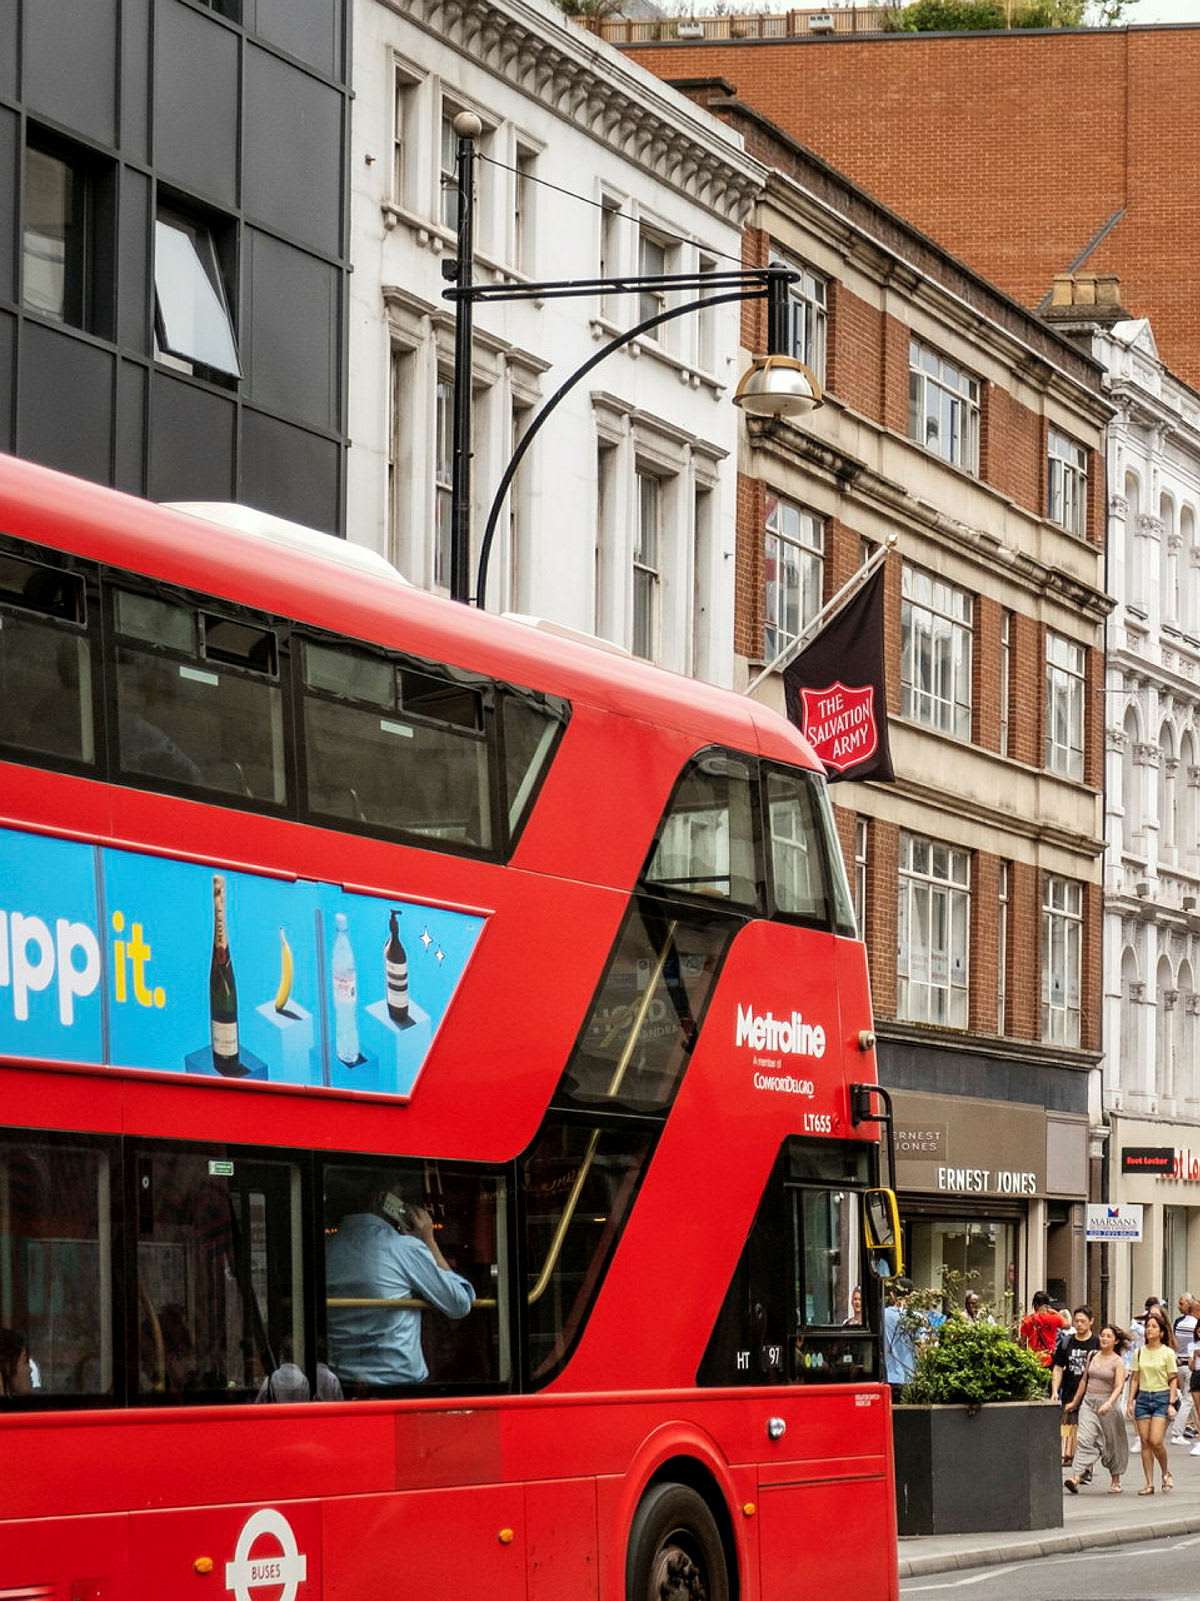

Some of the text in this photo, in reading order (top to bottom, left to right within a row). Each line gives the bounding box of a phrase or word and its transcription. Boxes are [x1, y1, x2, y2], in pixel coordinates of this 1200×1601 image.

[818, 693, 844, 718] THE
[808, 697, 871, 748] SALVATION
[833, 723, 868, 759] ARMY
[112, 910, 166, 1009] it.
[736, 1002, 826, 1059] Metroline
[803, 1113, 831, 1132] LT655
[938, 1167, 1036, 1195] ERNEST JONES
[1089, 1217, 1138, 1227] MARSANS
[737, 1352, 750, 1370] HT
[251, 1563, 281, 1581] BUSES
